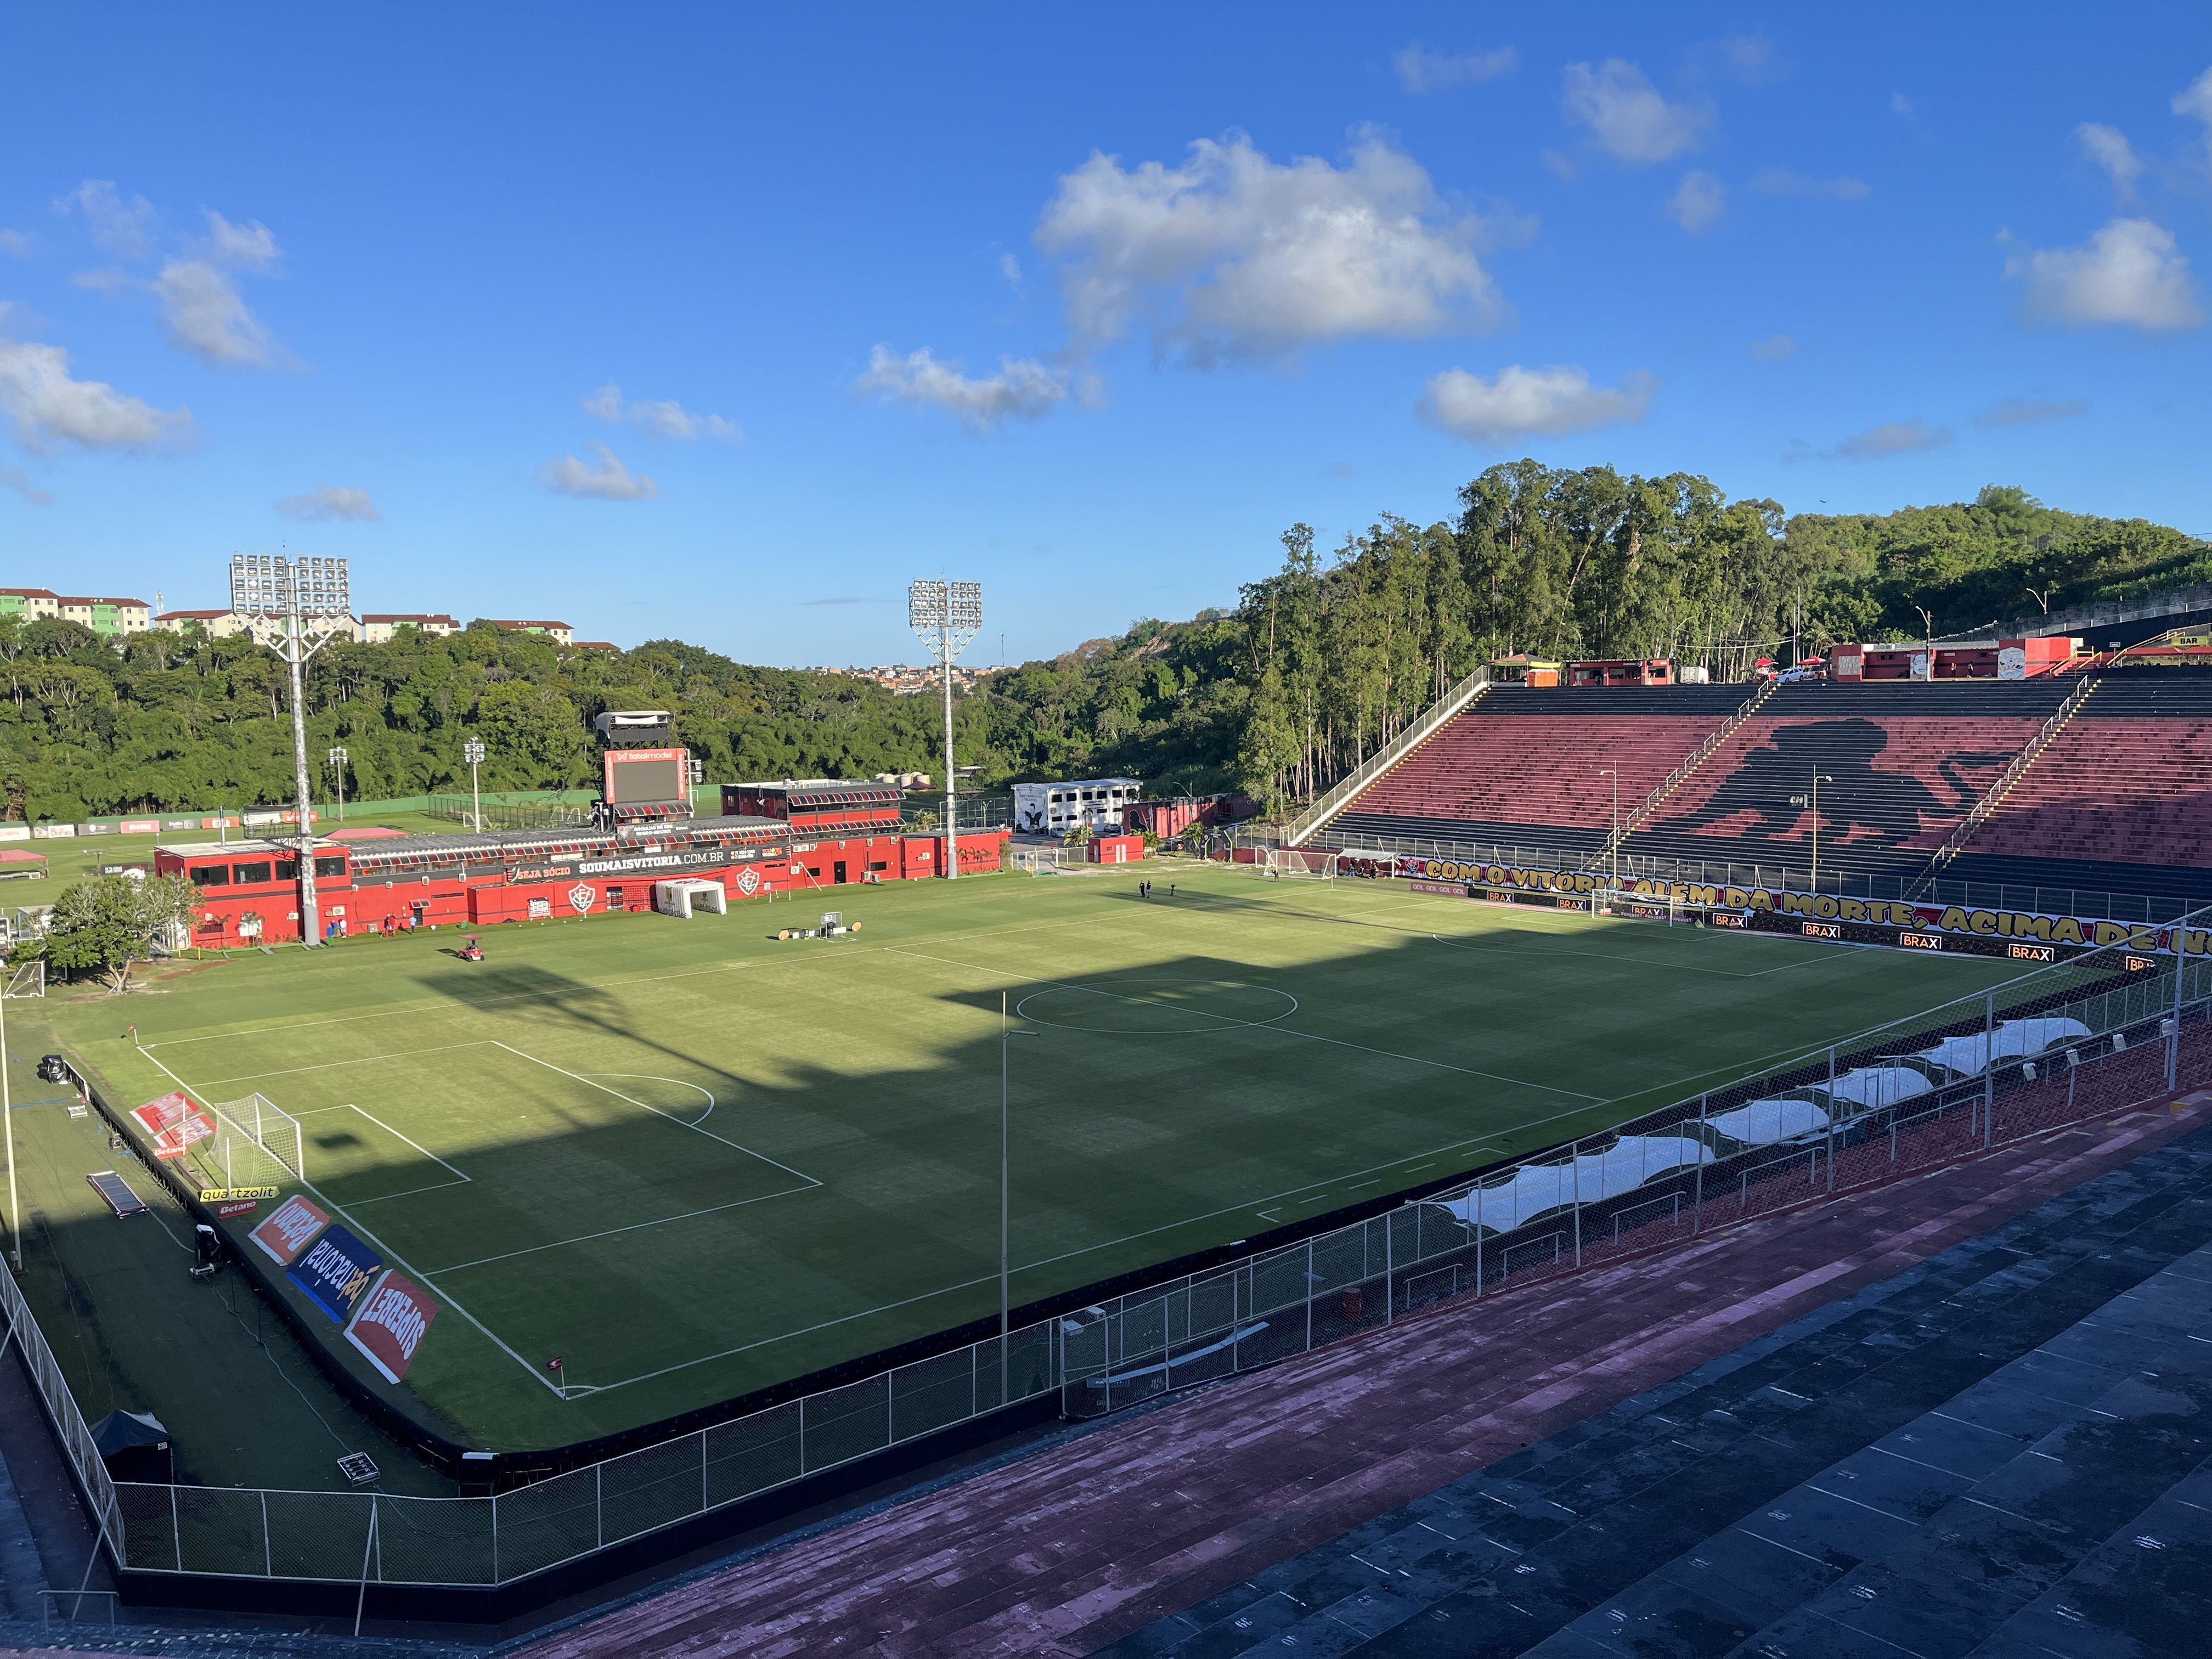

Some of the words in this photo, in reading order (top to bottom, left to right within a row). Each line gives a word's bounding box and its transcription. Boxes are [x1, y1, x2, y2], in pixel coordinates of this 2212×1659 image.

[629, 752, 672, 760] fatalmodel
[579, 851, 724, 874] SOUMAISVITORIA.COM.BR
[518, 870, 541, 879] SEJA
[543, 866, 571, 878] SÓCIO
[1489, 892, 1512, 903] BRAX
[1425, 859, 1481, 883] COM
[1486, 864, 1506, 884] O
[1630, 878, 1718, 906] ALÉM
[1724, 887, 1775, 912] DA
[1782, 891, 1929, 929] MORTE,
[1939, 906, 2085, 944] ACIMA
[2094, 921, 2160, 951] DE
[1560, 899, 1584, 910] BRAX
[1806, 925, 1837, 938] BRAX
[1904, 936, 1938, 950] BRAX
[2012, 947, 2050, 961] BRAX
[154, 1146, 187, 1156] Betano
[203, 1187, 274, 1201] quartzolit
[221, 1201, 256, 1214] Betano
[360, 1288, 426, 1360] SUPERBET
